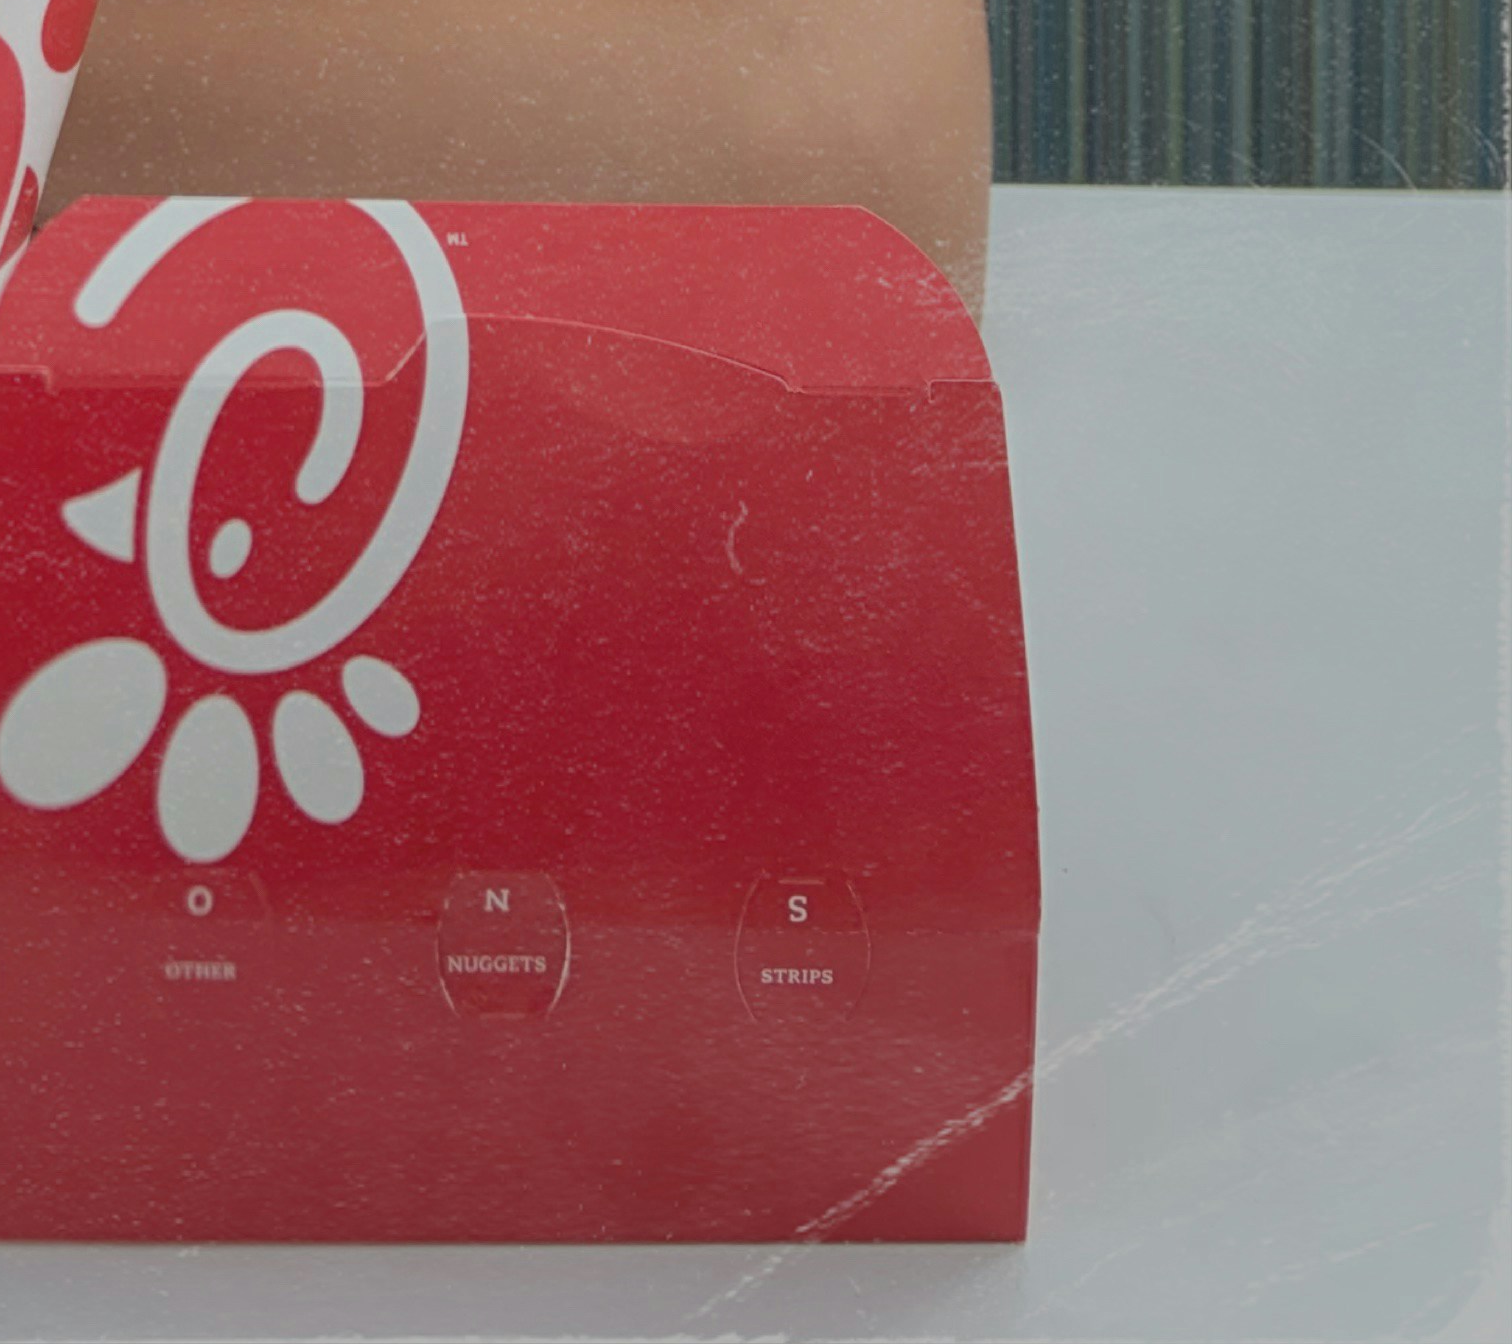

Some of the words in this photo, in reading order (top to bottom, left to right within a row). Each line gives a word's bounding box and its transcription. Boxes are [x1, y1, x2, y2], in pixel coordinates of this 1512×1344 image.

[187, 884, 213, 917] O
[483, 888, 511, 913] N
[787, 895, 808, 923] S
[164, 959, 237, 981] OTHER
[446, 954, 548, 974] NUGGETS
[760, 967, 834, 985] STRIPS
